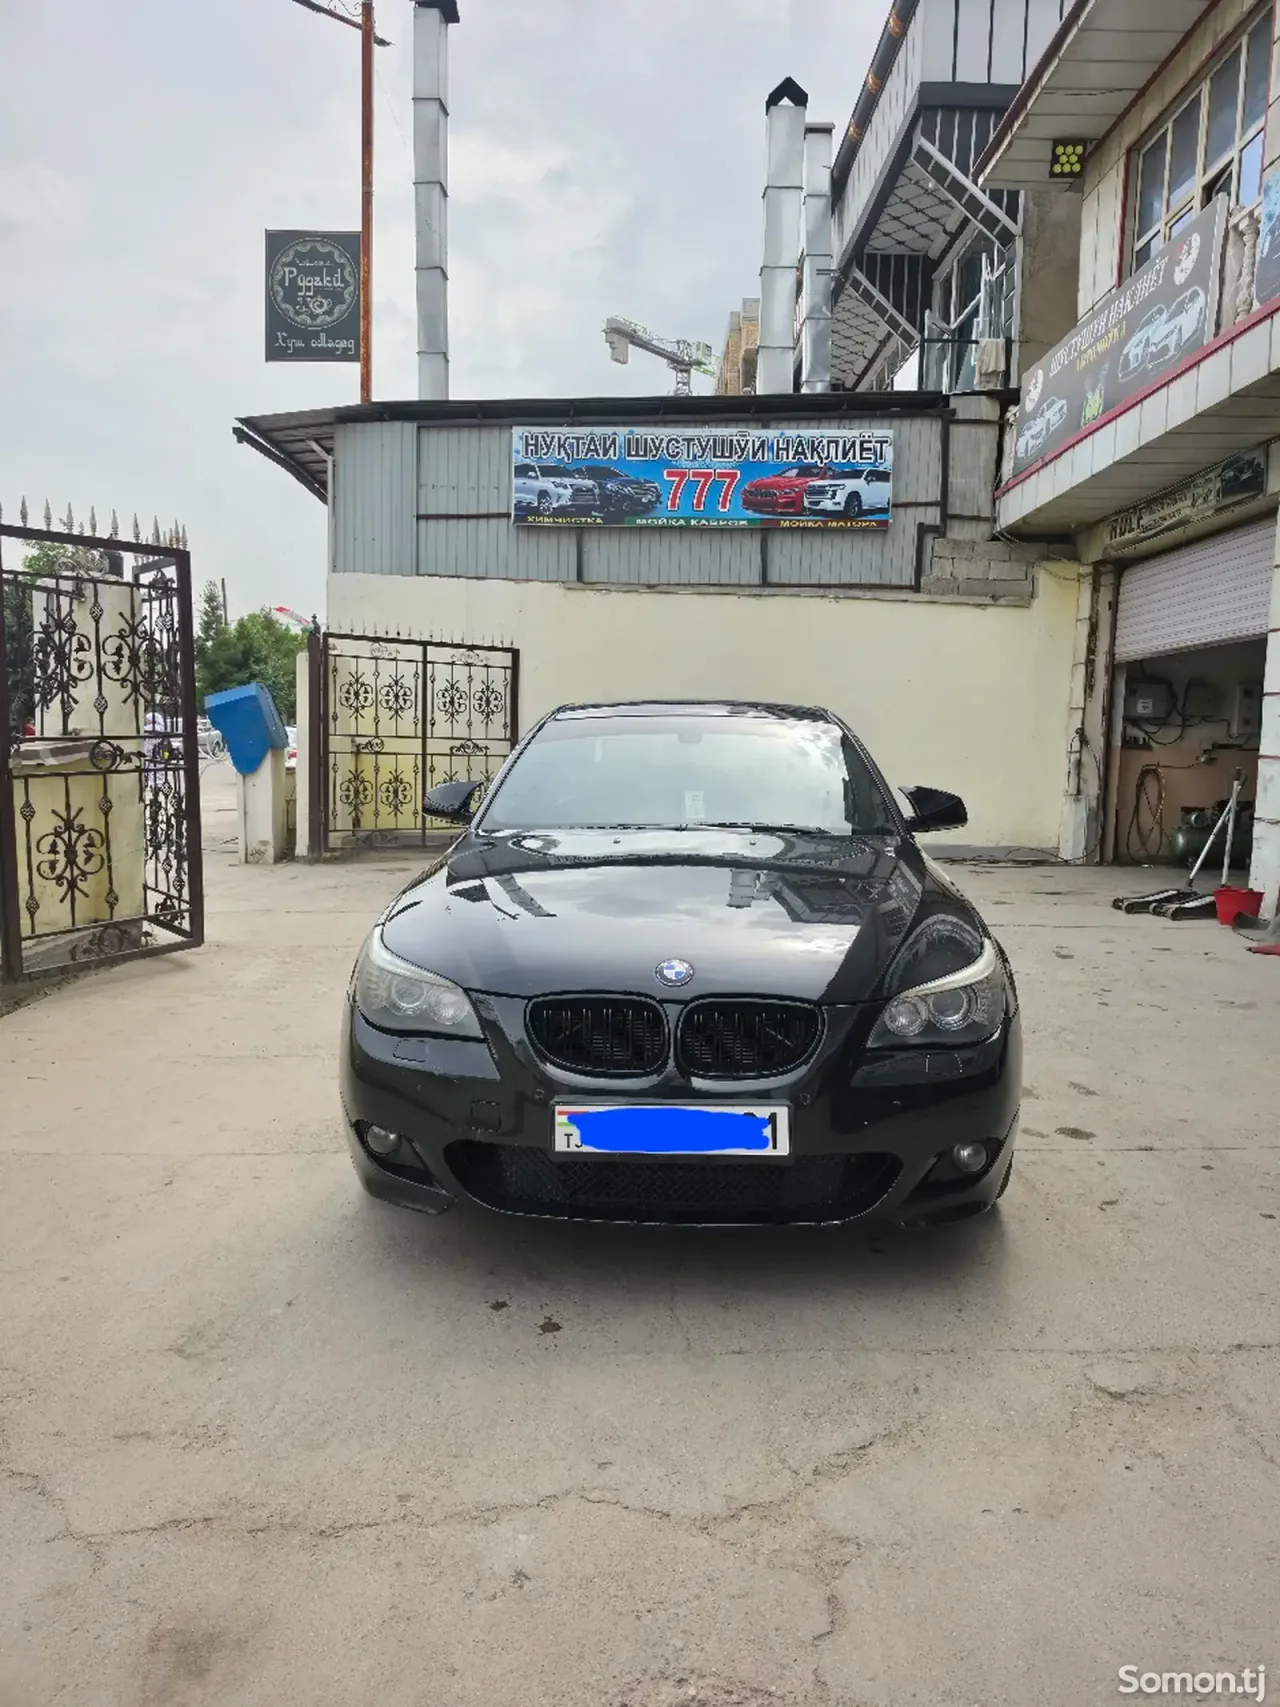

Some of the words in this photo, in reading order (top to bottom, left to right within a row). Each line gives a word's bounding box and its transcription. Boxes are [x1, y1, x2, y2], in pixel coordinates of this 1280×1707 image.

[523, 433, 618, 462] НУҚТАИ
[776, 433, 889, 466] НАҚЛИЁТ
[664, 469, 740, 512] 777
[527, 516, 604, 524] ХИМЧИСТКА
[636, 517, 686, 526] МОЙКА
[780, 520, 823, 528] МОЙКА
